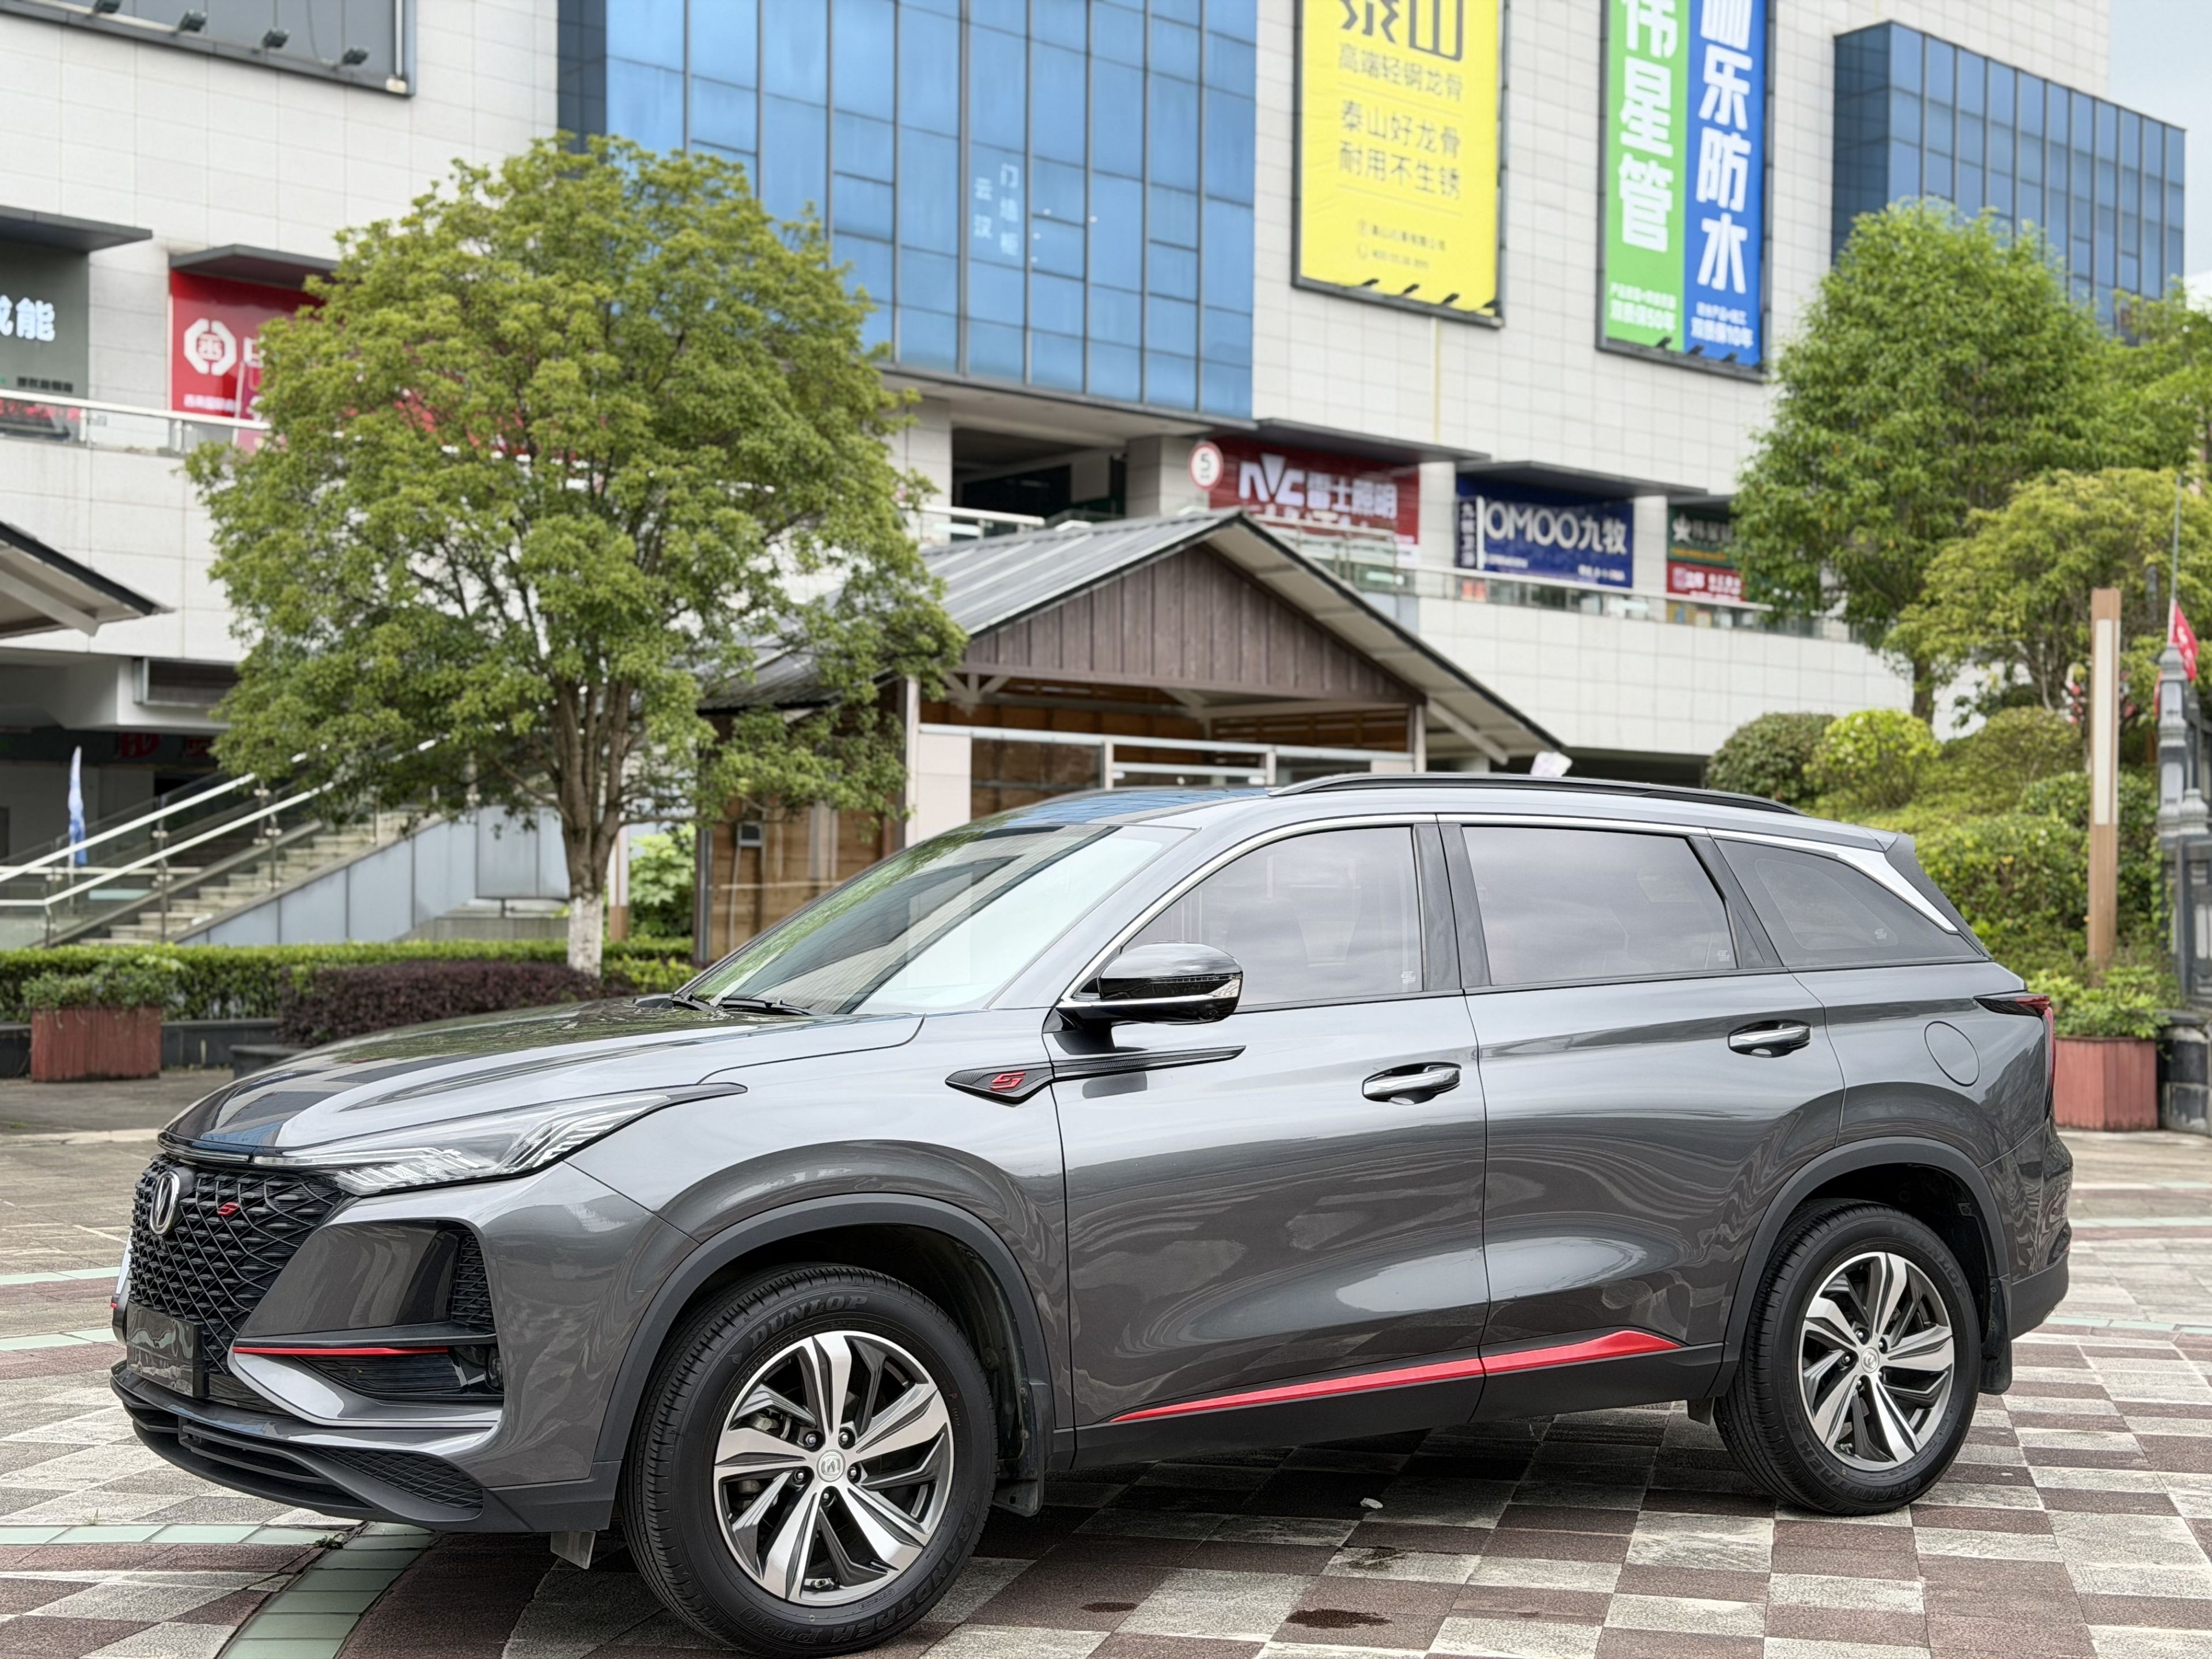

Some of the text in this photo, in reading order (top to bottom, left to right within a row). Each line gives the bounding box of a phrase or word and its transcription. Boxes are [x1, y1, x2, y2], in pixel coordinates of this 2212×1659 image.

[1341, 100, 1461, 159] 泰山好龙骨
[1339, 140, 1460, 200] 耐用不生锈
[750, 1296, 868, 1350] DUNLOP
